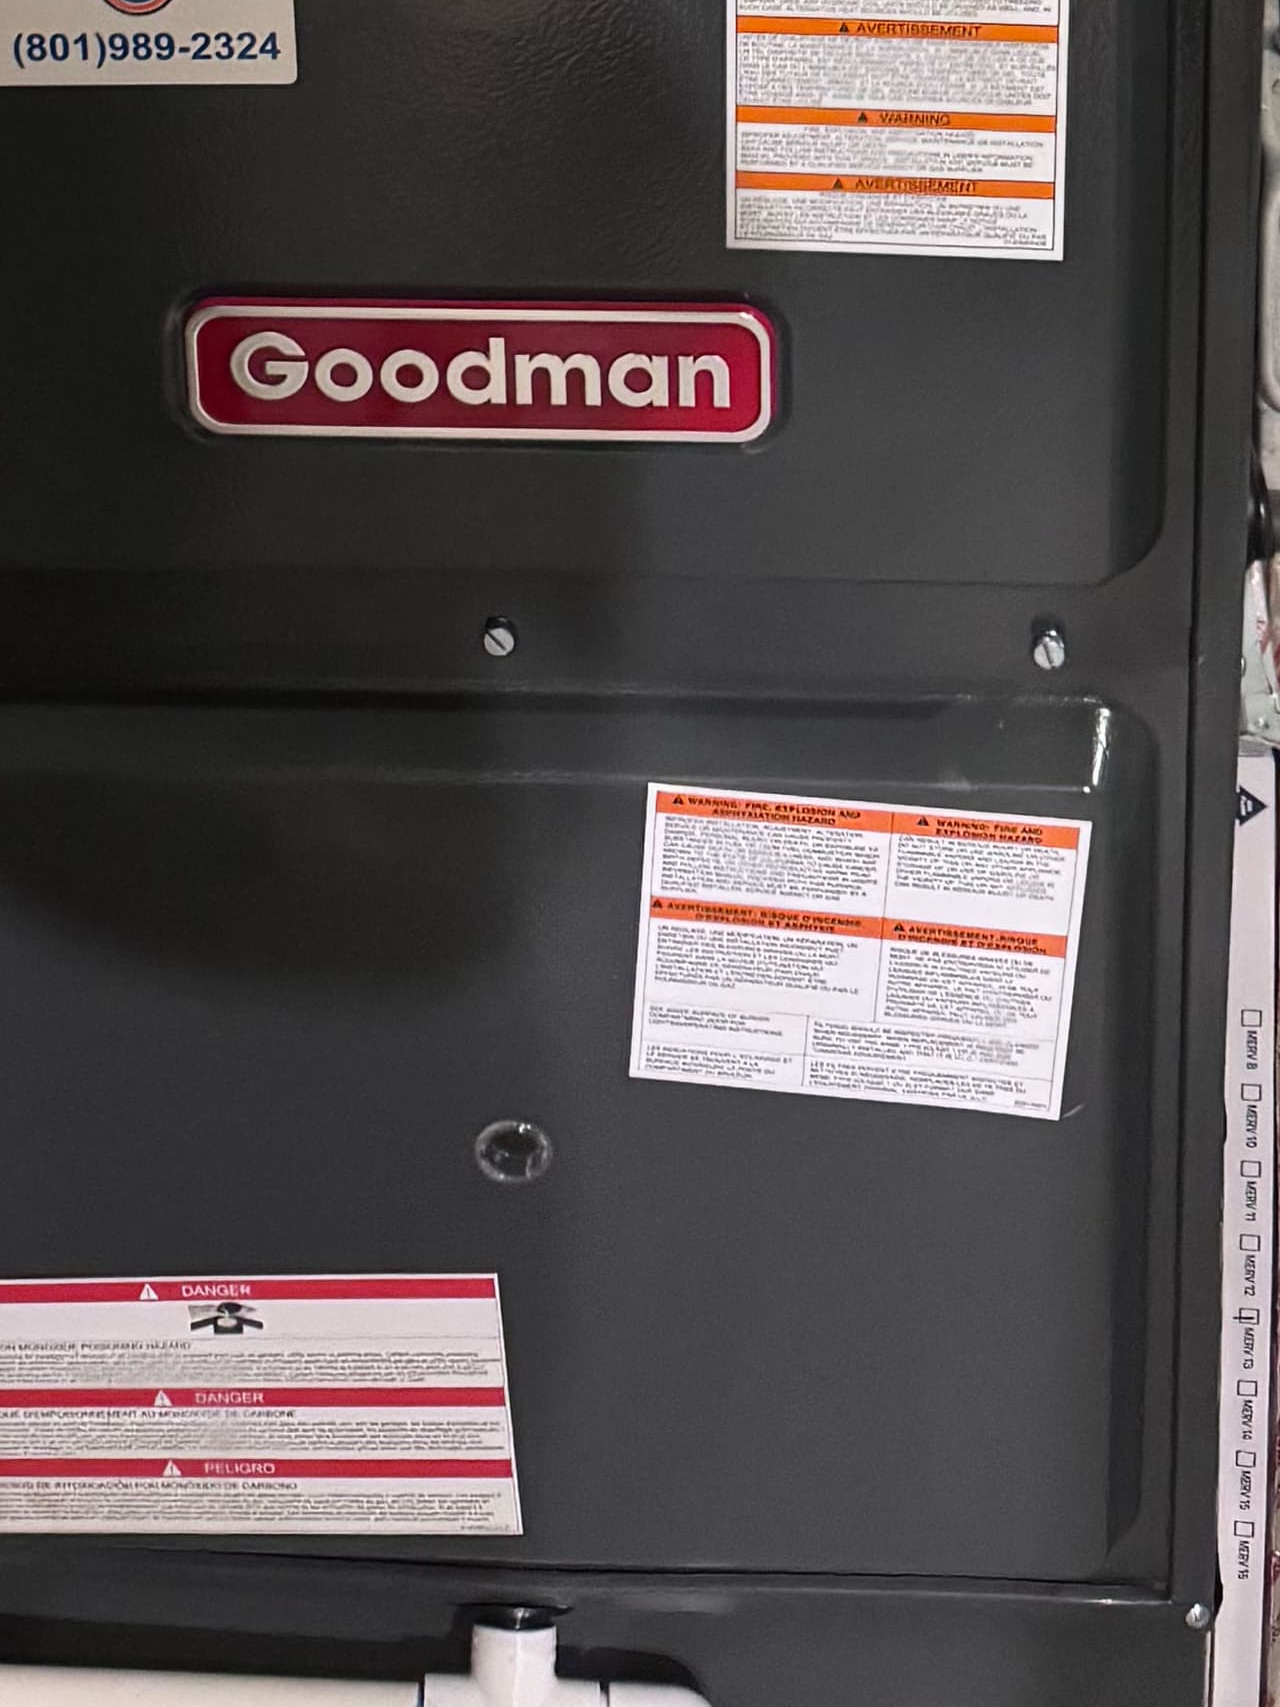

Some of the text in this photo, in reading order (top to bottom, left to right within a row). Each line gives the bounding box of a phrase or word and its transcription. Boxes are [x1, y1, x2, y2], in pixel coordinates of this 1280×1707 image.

[856, 22, 982, 38] AVERTISSEMENT
[12, 30, 281, 69] (801)989-2324
[879, 113, 950, 127] WARNING
[229, 331, 731, 408] Goodman
[1246, 1030, 1259, 1061] MERV
[1245, 1105, 1259, 1148] MERV 10
[1244, 1181, 1258, 1222] MERV 11
[181, 1283, 251, 1297] DANGER
[1243, 1255, 1257, 1296] MERV 12
[1242, 1327, 1255, 1370] MERV 13
[195, 1392, 265, 1404] DANGER
[1242, 1399, 1254, 1429] MERV
[205, 1462, 276, 1475] PELIGRO
[1240, 1469, 1252, 1499] MERV
[1238, 1540, 1250, 1569] MERV
